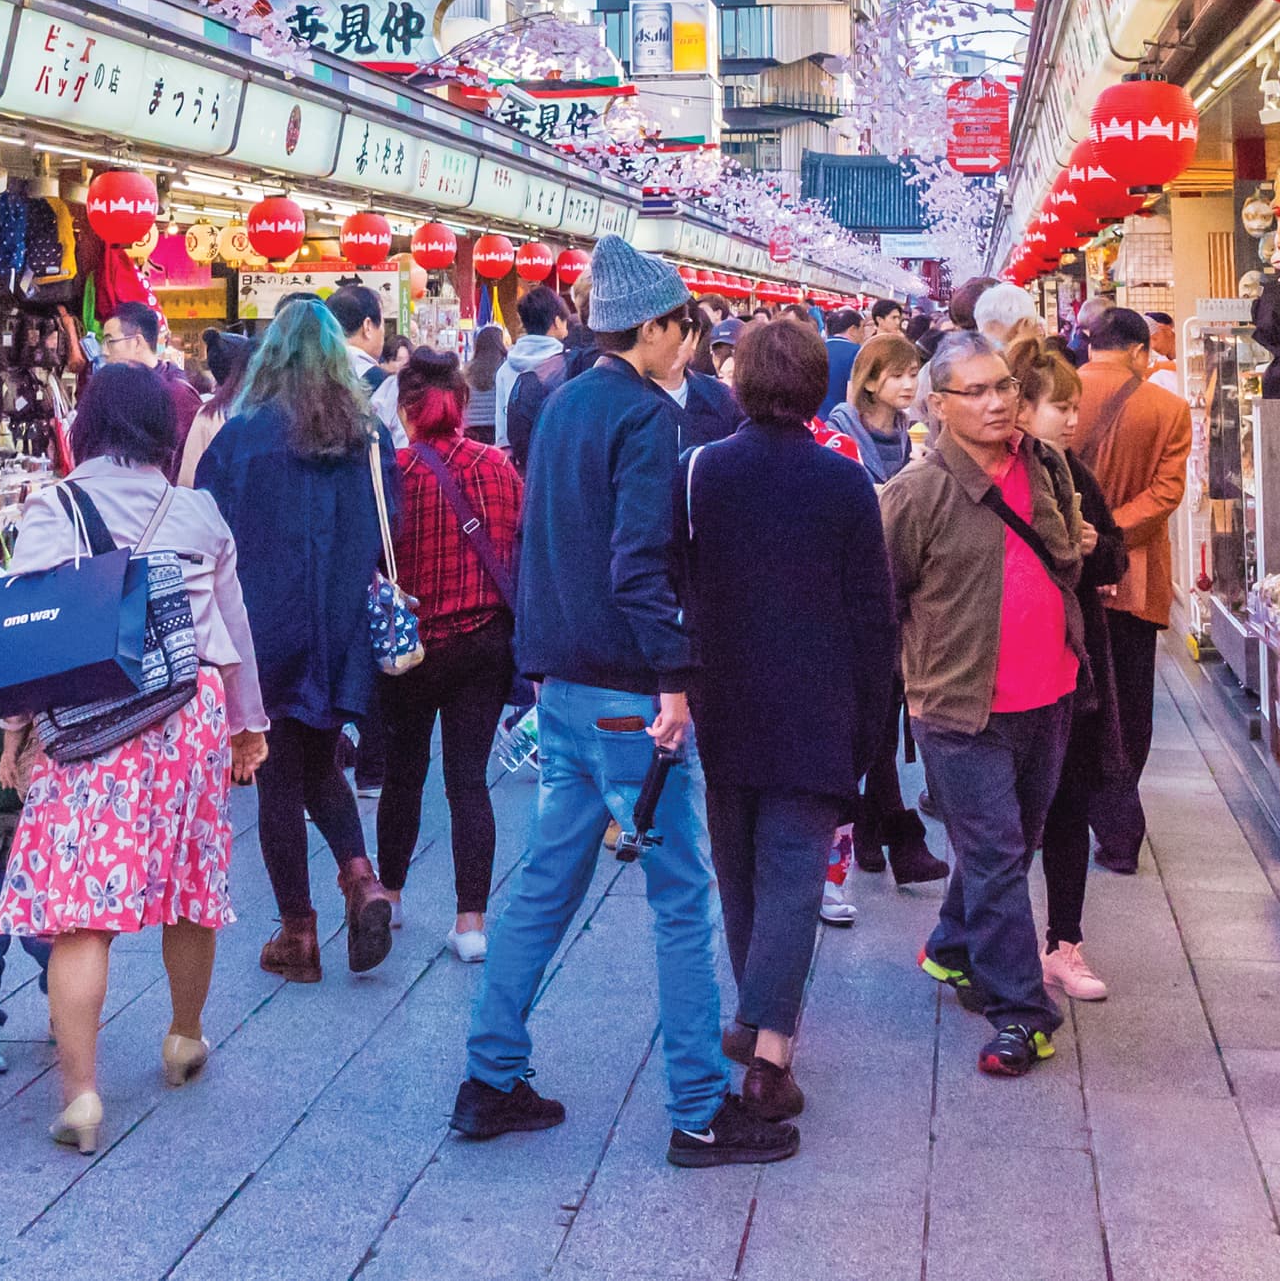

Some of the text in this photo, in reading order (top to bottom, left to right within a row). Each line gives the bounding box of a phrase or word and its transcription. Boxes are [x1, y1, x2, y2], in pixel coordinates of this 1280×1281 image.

[35, 65, 89, 103] バッグ
[93, 63, 121, 96] の店
[147, 76, 221, 131] まつうら
[3, 607, 61, 628] one way
